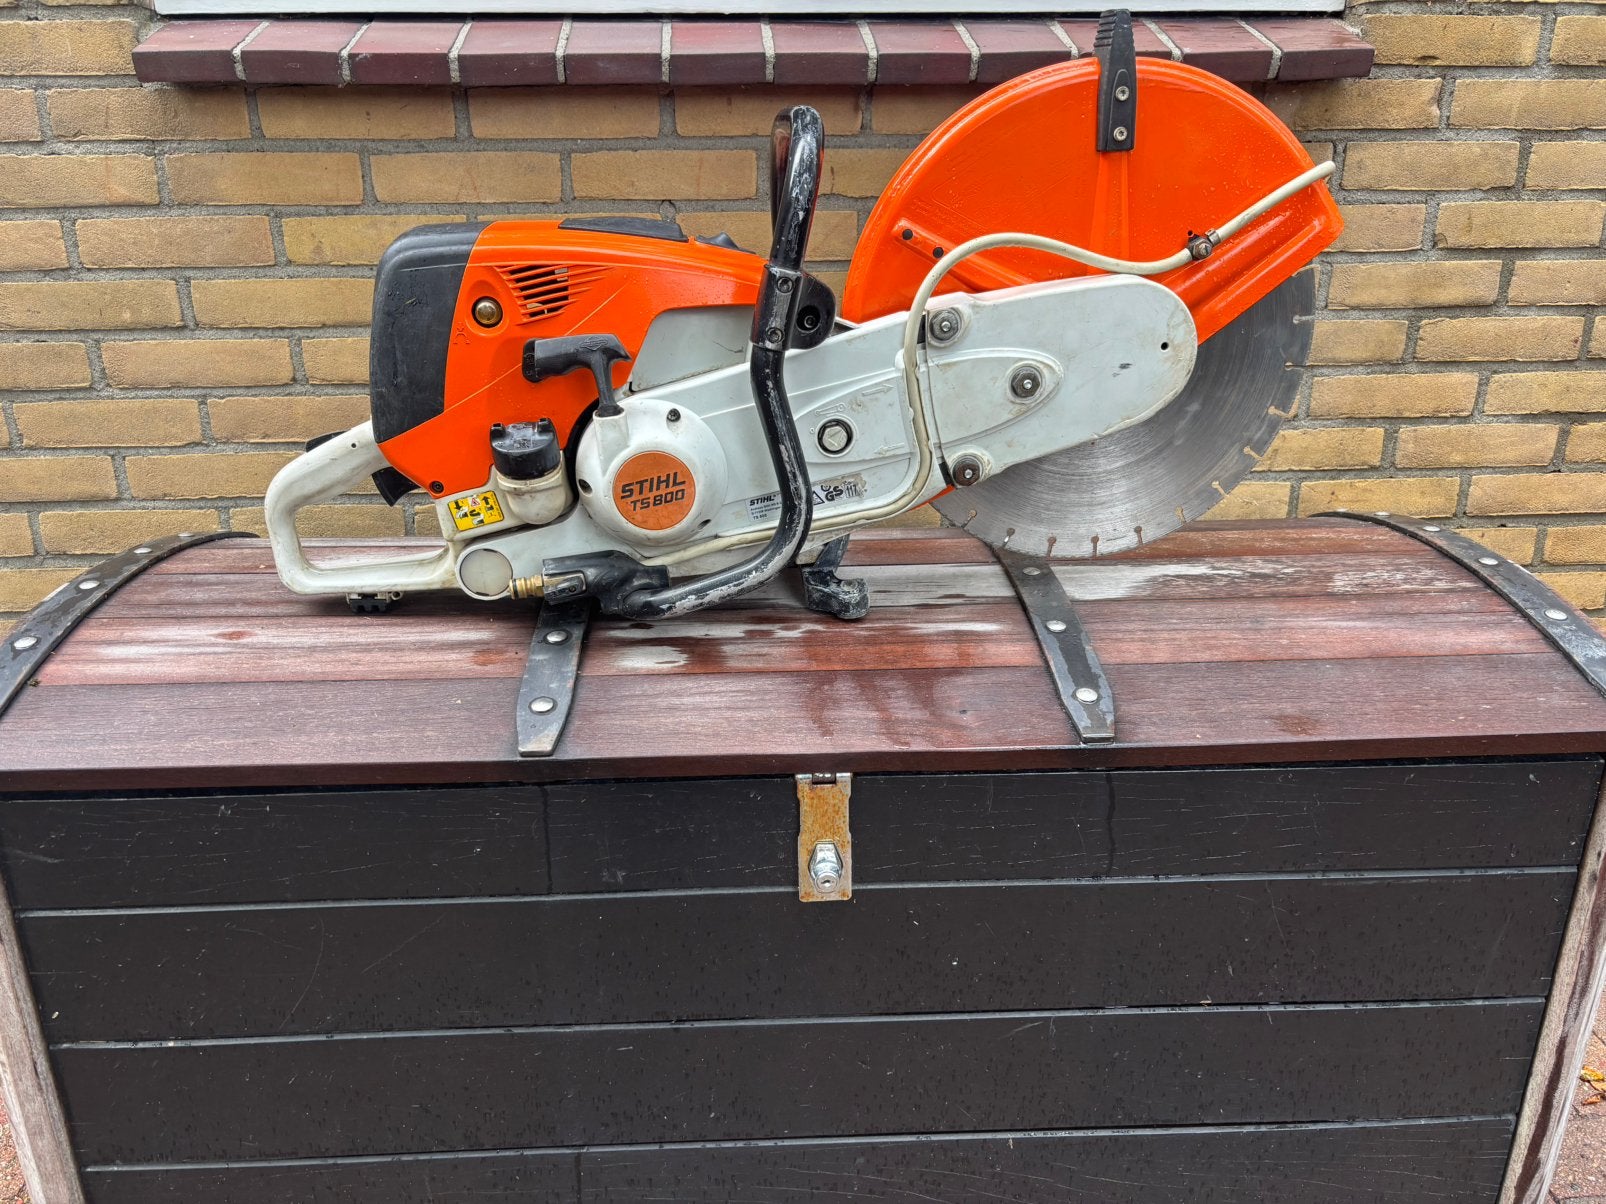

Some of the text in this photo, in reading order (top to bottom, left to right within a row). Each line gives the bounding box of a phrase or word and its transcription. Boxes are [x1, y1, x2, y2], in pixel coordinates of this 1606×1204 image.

[620, 472, 687, 500] STIHL
[825, 485, 844, 502] GS
[749, 495, 775, 507] STIHL
